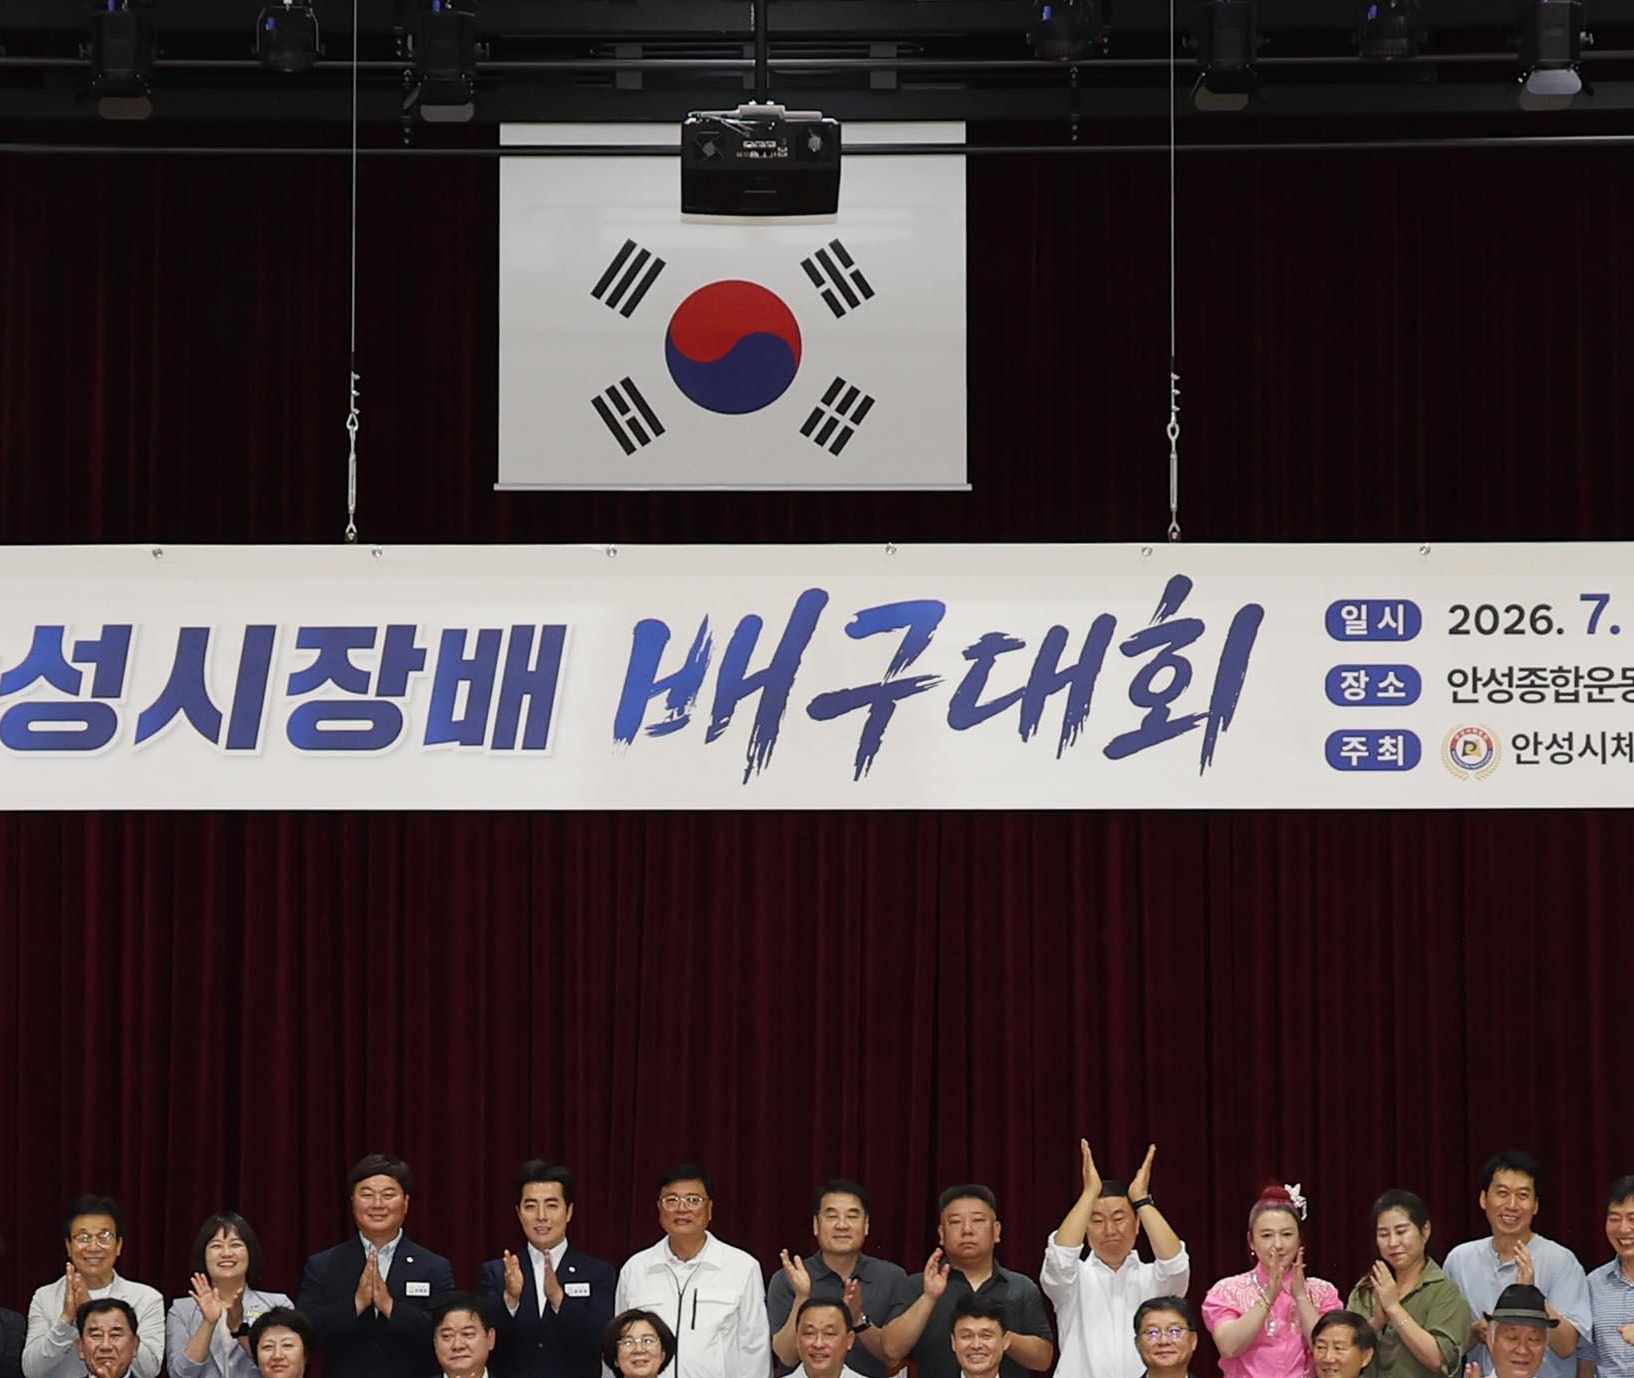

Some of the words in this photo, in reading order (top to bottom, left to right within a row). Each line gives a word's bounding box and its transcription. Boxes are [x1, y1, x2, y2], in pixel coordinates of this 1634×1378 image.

[1448, 604, 1565, 636] 2026.
[1579, 593, 1621, 635] 7.
[612, 574, 1266, 785] 배구대회
